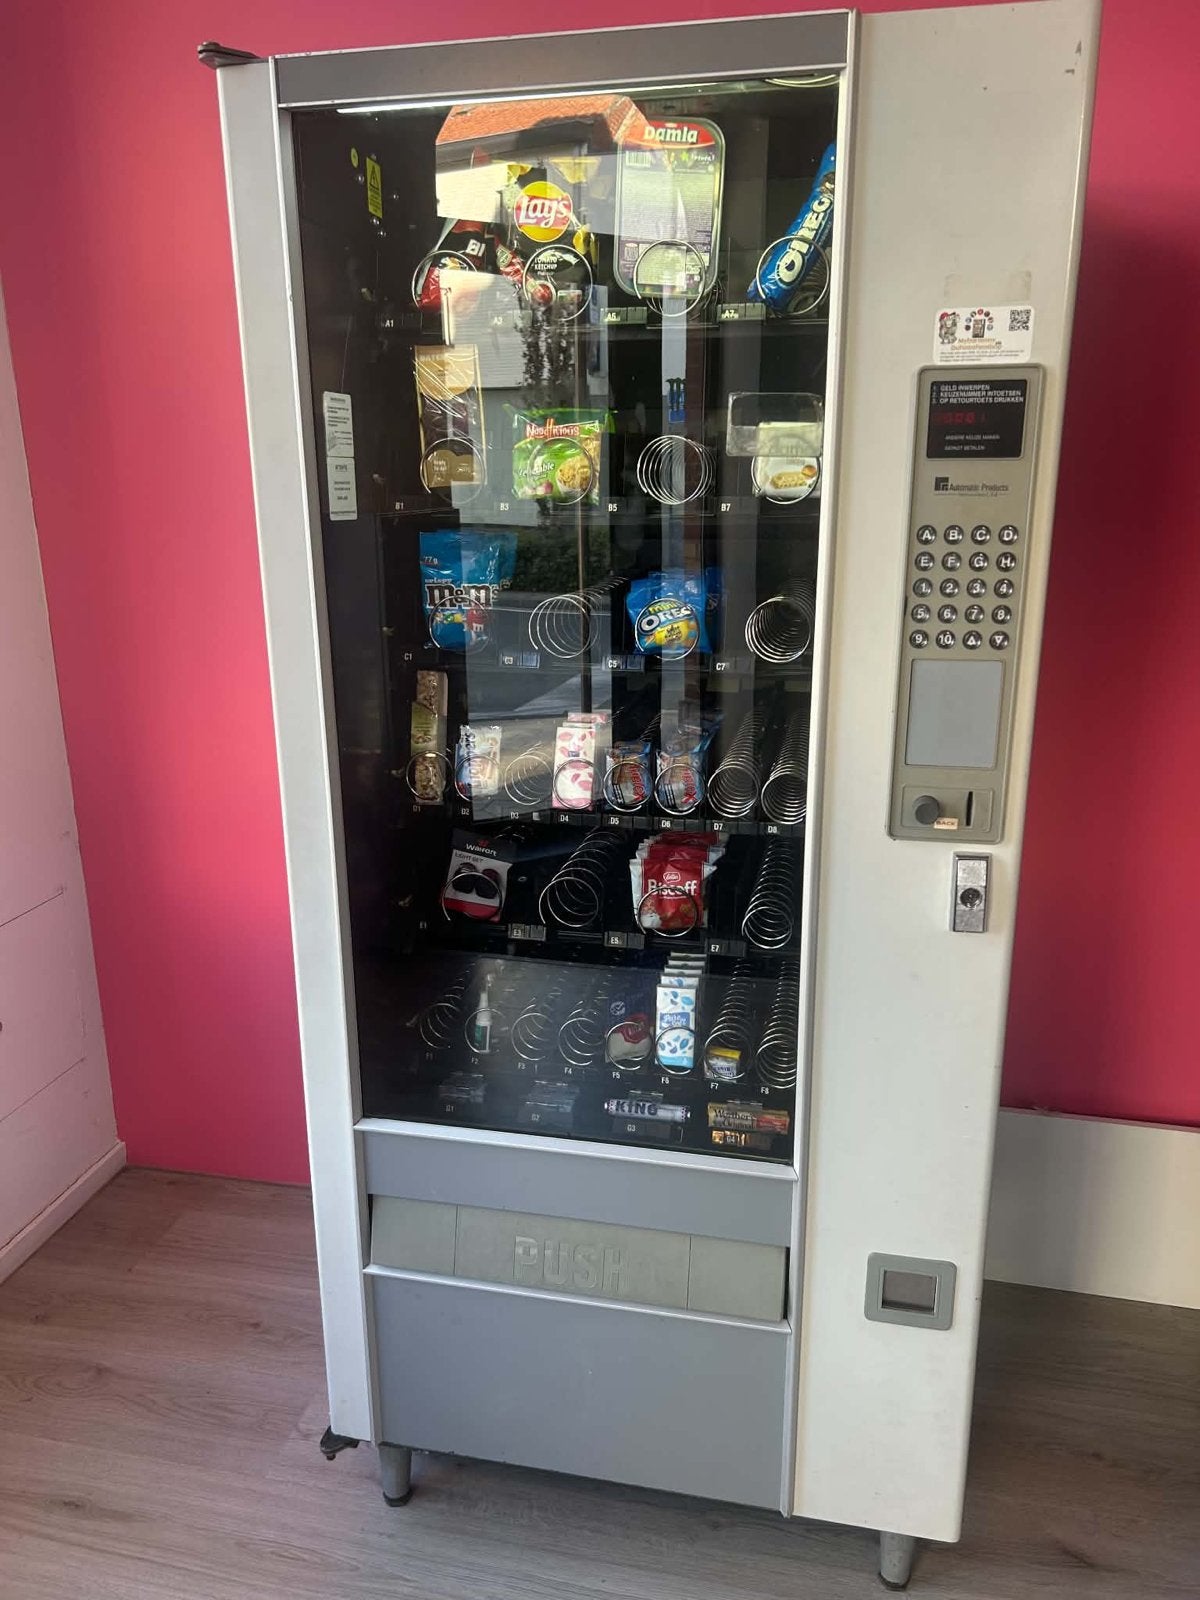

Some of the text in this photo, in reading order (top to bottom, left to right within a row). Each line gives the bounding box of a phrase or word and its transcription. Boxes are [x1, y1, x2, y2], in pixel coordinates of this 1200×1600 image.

[644, 126, 698, 143] Damla
[518, 195, 570, 227] Lay's
[534, 263, 558, 271] KETCHUP
[949, 482, 1009, 491] Automatic Products
[500, 502, 509, 511] B3
[608, 503, 618, 512] B5
[720, 503, 731, 512] B7
[649, 602, 677, 614] mini
[404, 652, 413, 661] C1
[715, 663, 725, 671] C7
[610, 817, 620, 825] D5
[661, 820, 671, 828] D6
[713, 822, 724, 831] D7
[767, 825, 778, 833] D8
[647, 879, 698, 896] Biscoff
[711, 944, 719, 952] E7
[518, 1062, 526, 1070] F3
[612, 1071, 621, 1079] F5
[661, 1076, 670, 1084] F6
[710, 1082, 719, 1090] F7
[760, 1087, 769, 1095] F8
[615, 1100, 658, 1116] KING
[627, 1124, 636, 1132] G3
[513, 1235, 624, 1294] PUSH
